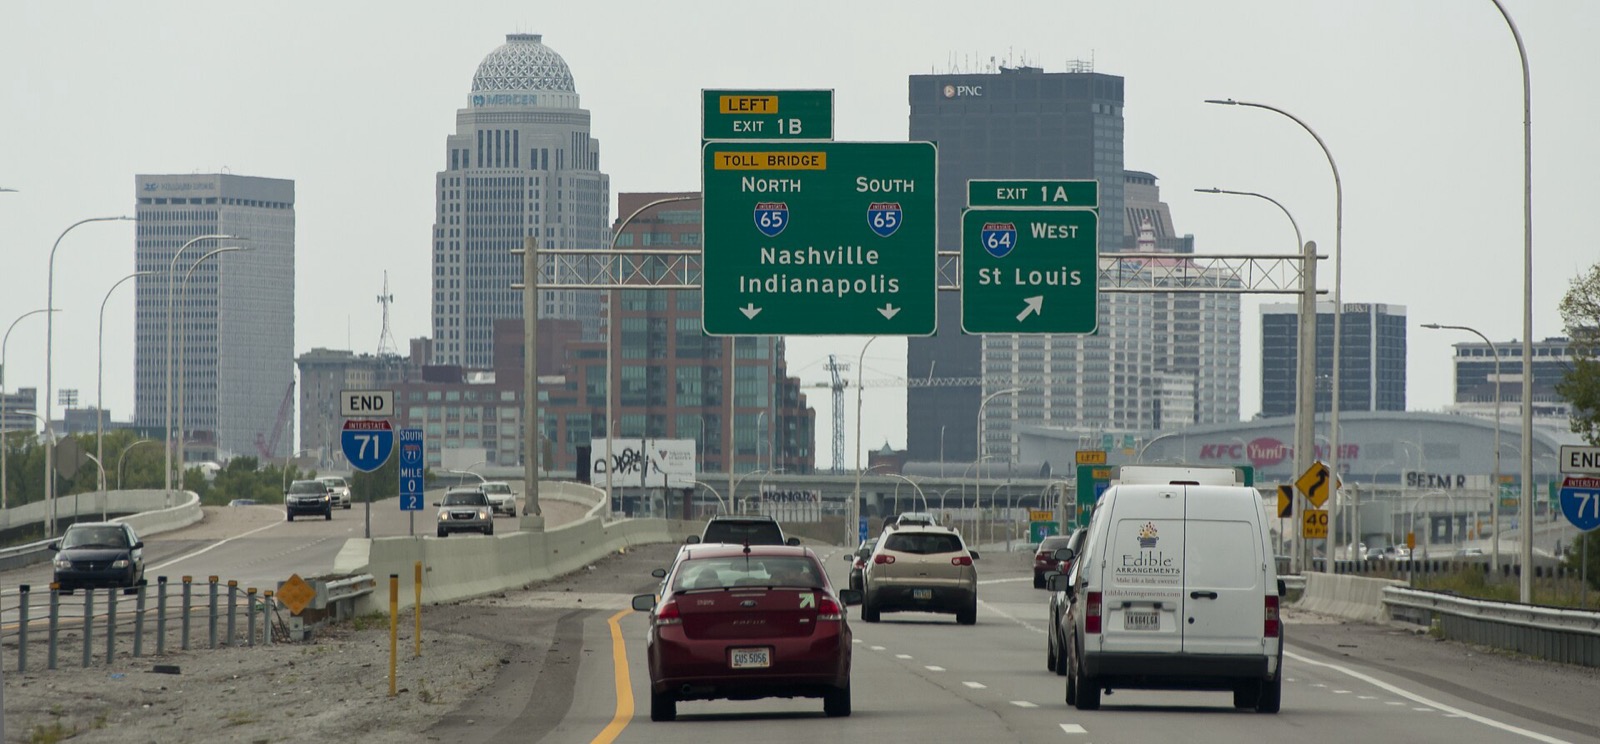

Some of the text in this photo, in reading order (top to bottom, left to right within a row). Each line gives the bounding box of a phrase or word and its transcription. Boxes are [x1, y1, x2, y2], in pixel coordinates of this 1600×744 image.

[957, 85, 983, 97] PNC
[486, 94, 538, 105] MERCER
[728, 98, 769, 112] LEFT
[733, 119, 802, 135] EXIT 1B
[723, 155, 820, 167] TOLL BRIDGE
[997, 186, 1069, 202] EXIT 1A
[760, 212, 783, 228] 65
[873, 212, 896, 228] 65
[987, 232, 1011, 249] 64
[760, 247, 880, 265] Nashville
[978, 266, 1082, 286] St Louis
[739, 275, 900, 298] Indianapolis
[350, 395, 384, 411] END
[400, 431, 423, 441] SOUTH
[354, 434, 379, 460] 71
[1199, 443, 1243, 460] KFC
[406, 451, 416, 460] 71
[401, 468, 422, 478] MILE
[408, 480, 416, 492] 0
[407, 496, 416, 509] .2
[1573, 492, 1600, 519] 71
[1306, 513, 1329, 526] 40
[1122, 550, 1173, 567] Edible
[1104, 589, 1181, 598] EdibleArrangements.com
[749, 652, 767, 663] 5056
